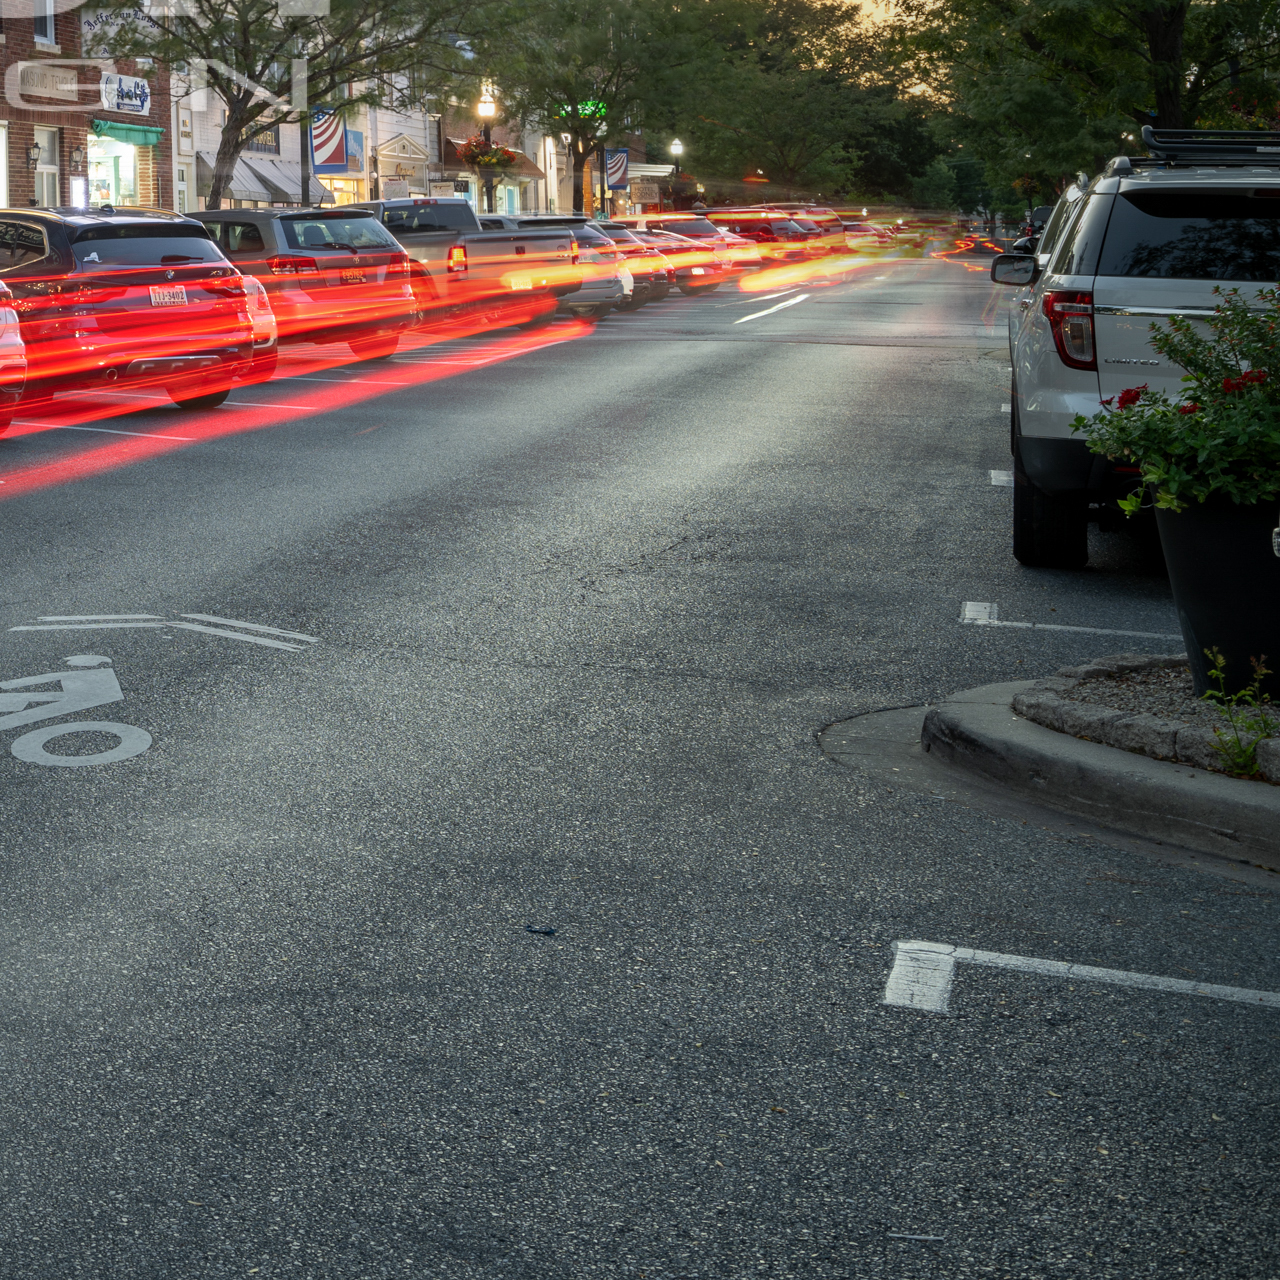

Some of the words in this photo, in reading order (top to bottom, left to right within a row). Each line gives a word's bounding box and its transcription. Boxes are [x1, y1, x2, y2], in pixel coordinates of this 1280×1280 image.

[84, 11, 131, 31] Jefferson
[20, 70, 48, 89] MASONIC
[51, 74, 75, 93] TEMPLE
[1104, 357, 1159, 366] LIMITED
